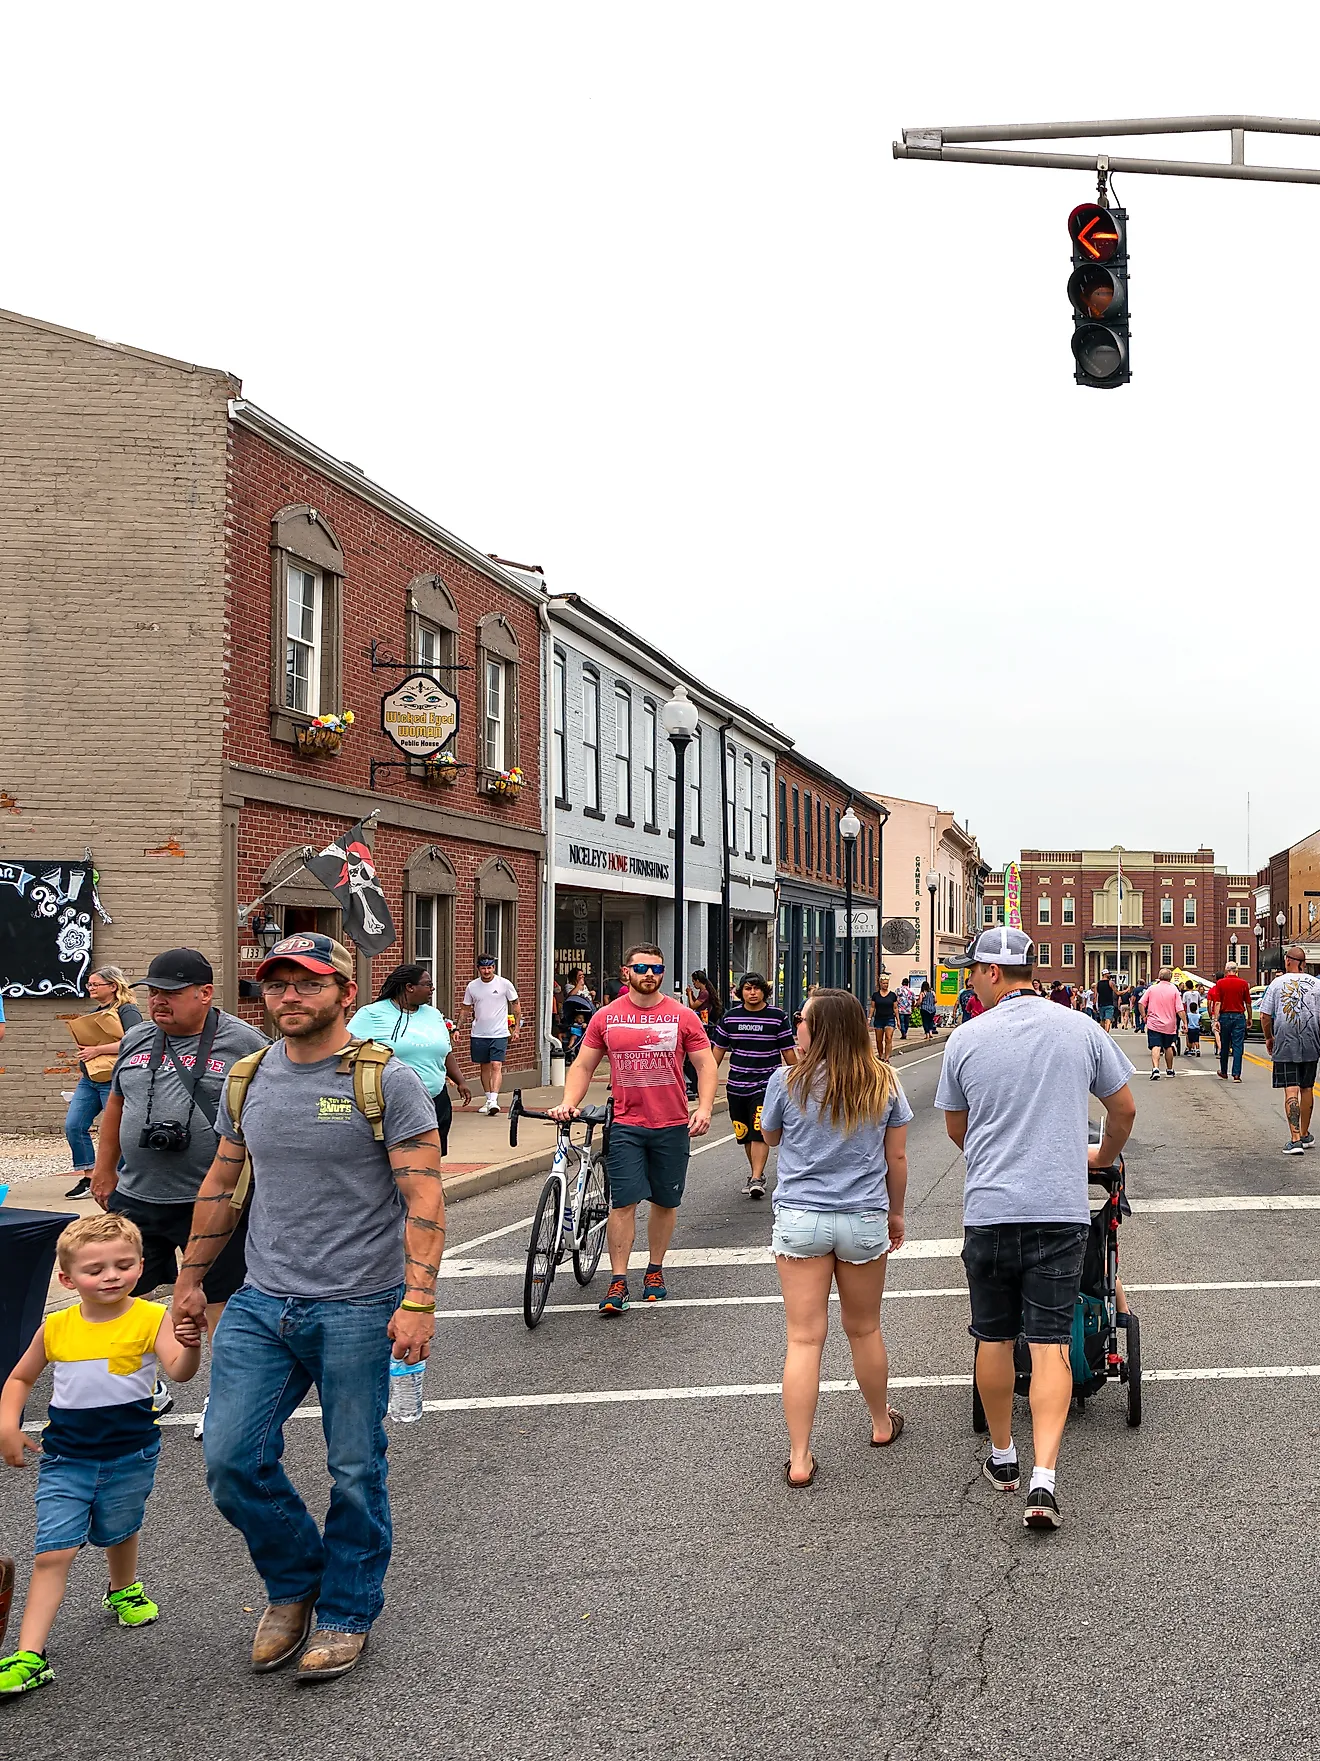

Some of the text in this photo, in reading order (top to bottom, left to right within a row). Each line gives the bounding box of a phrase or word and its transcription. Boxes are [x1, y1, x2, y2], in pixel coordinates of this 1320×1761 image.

[385, 711, 455, 727] Wicked Eyed
[568, 843, 669, 880] NICELEY'S HOME FURNISHINGS
[914, 900, 921, 913] OF
[278, 939, 311, 953] STP
[246, 947, 260, 958] 133
[606, 1013, 680, 1024] PALM BEACH
[737, 1023, 764, 1032] BROKEN
[624, 1052, 651, 1060] SOUTH
